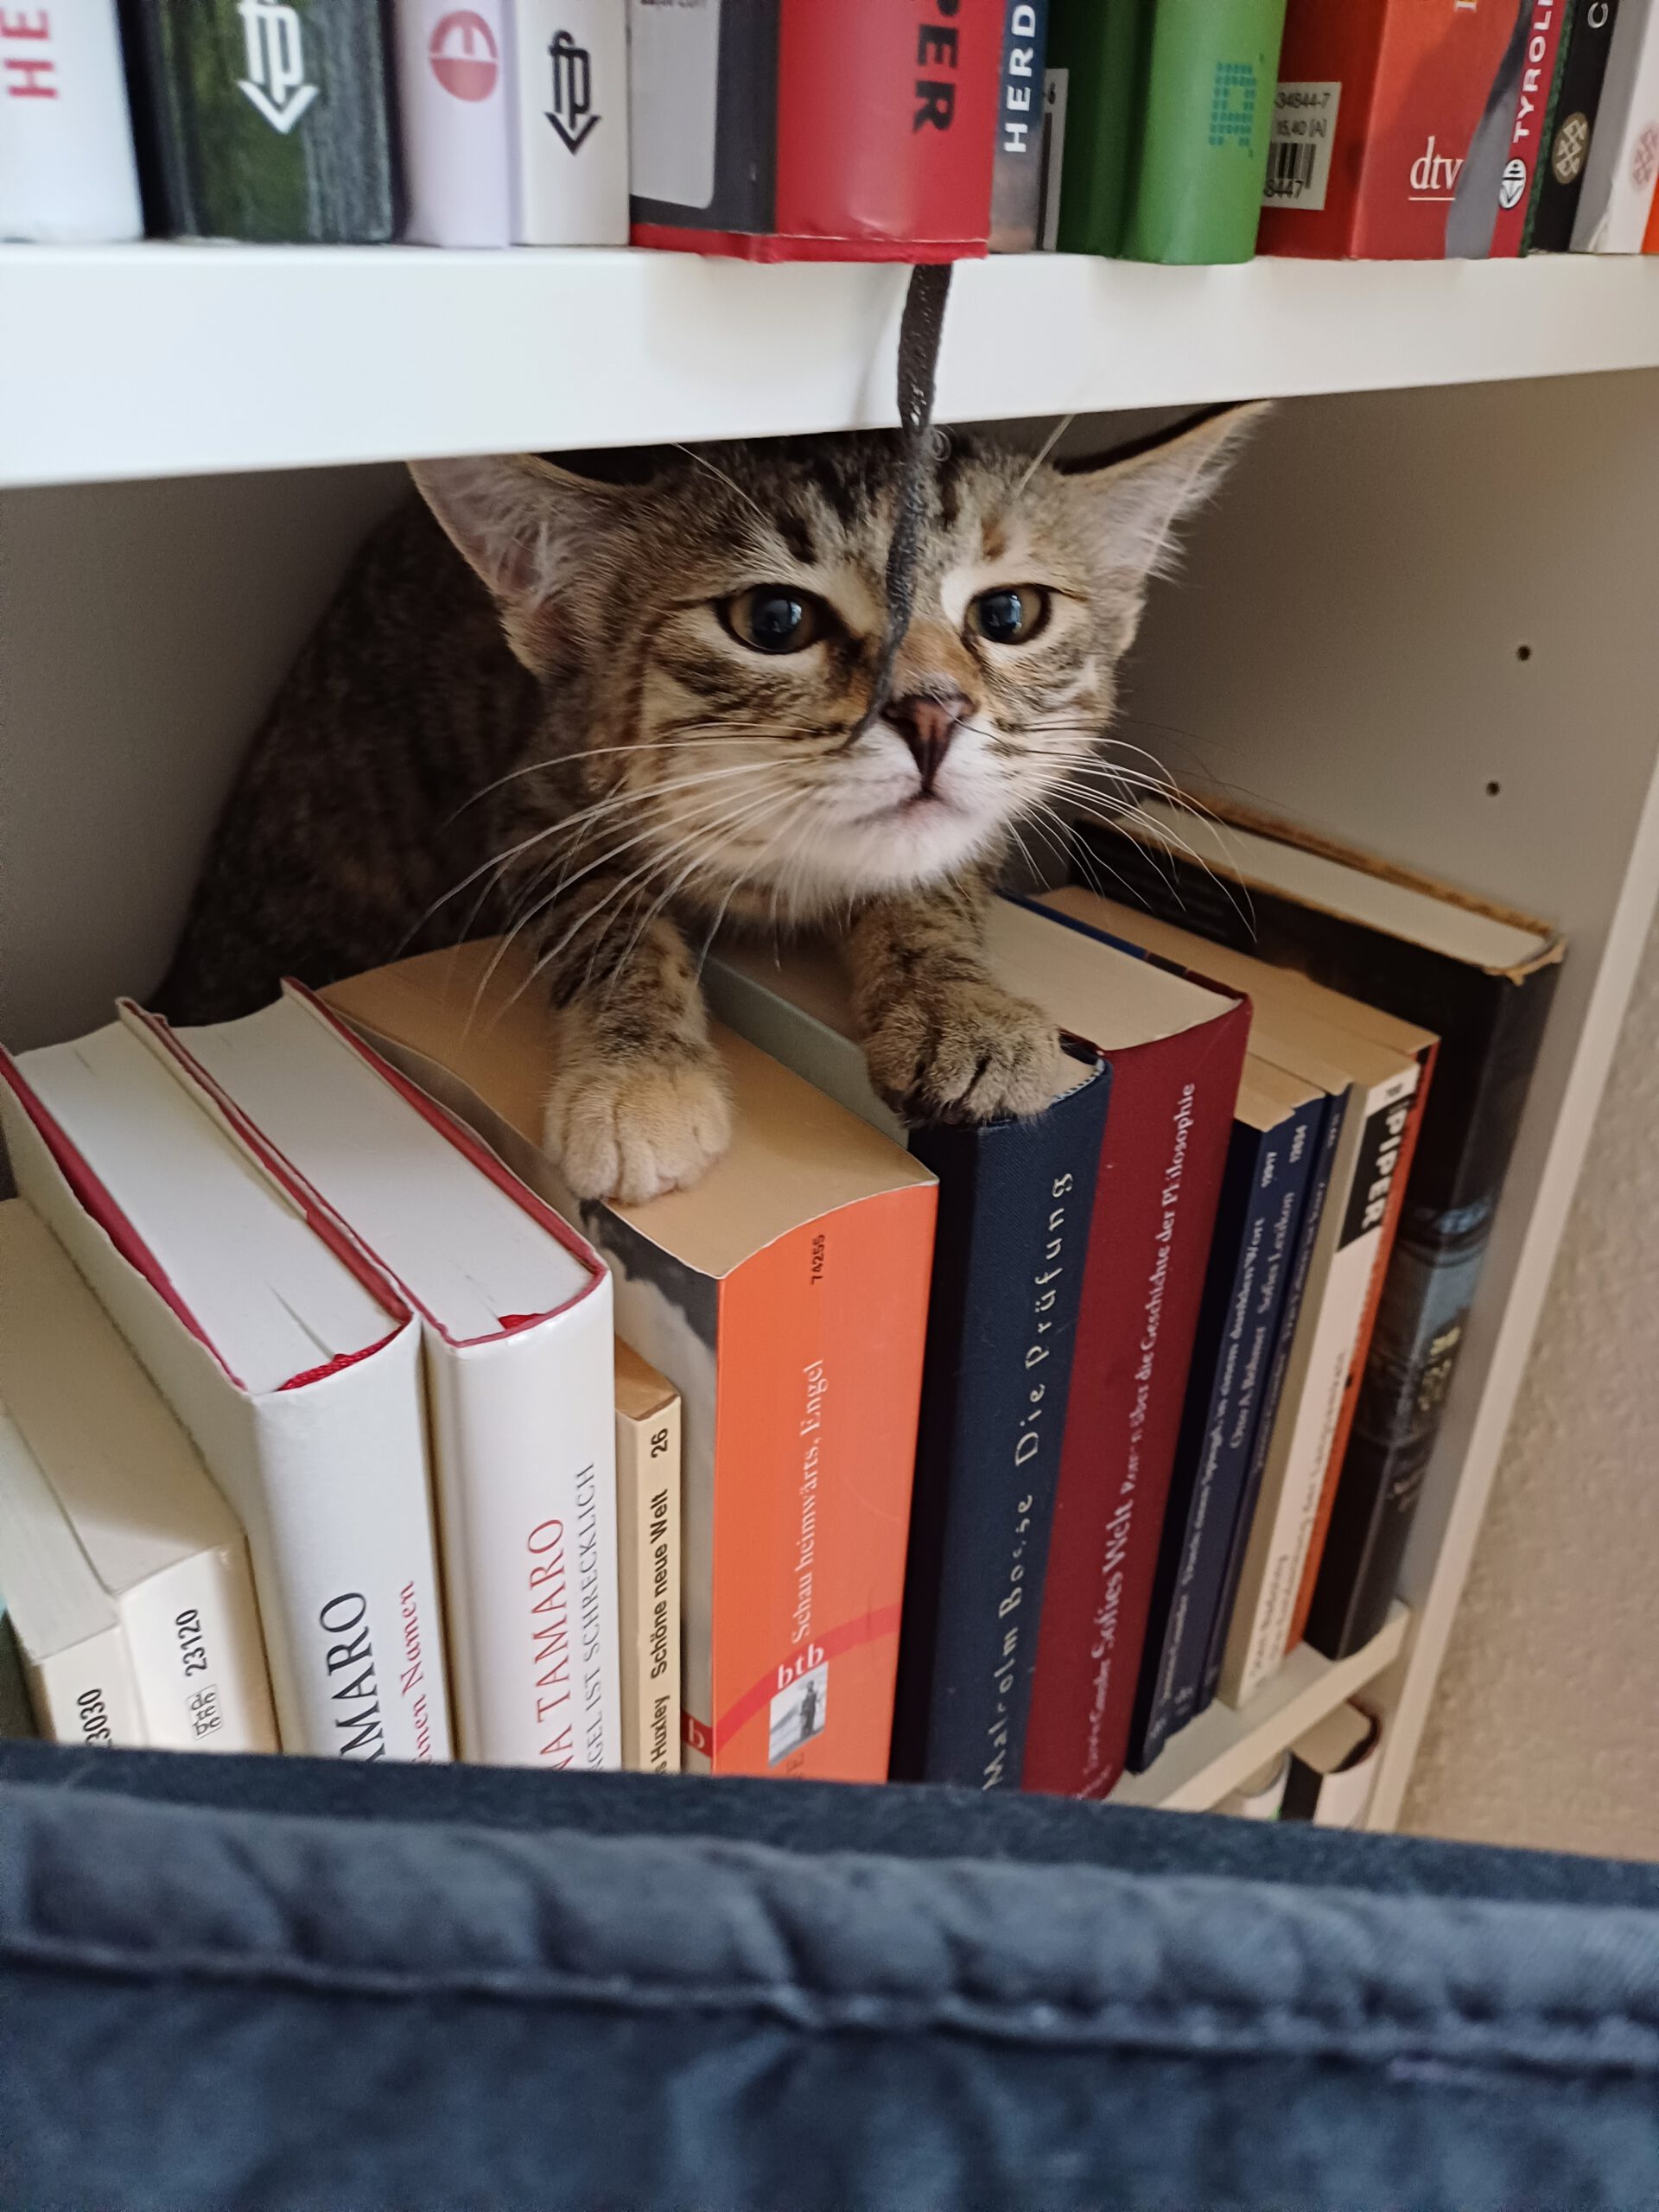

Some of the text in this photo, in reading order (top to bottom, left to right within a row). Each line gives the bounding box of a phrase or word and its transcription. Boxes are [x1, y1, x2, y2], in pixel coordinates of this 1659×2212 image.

[1003, 4, 1036, 153] HERD
[1409, 136, 1465, 191] dtv
[1161, 1082, 1197, 1207] Philosophie
[1361, 1109, 1408, 1230] PIPER
[810, 1233, 826, 1286] 74255
[1155, 1210, 1177, 1243] der
[1025, 1173, 1073, 1370] Prüfung
[1141, 1243, 1172, 1351] Geschichte
[799, 1358, 829, 1438] Engel
[1135, 1351, 1155, 1382] die
[650, 1427, 669, 1459] 26
[1014, 1382, 1046, 1467] Die
[650, 1489, 669, 1544] Welt
[575, 1462, 601, 1662] SCHRECKLICH
[654, 1544, 669, 1597] neue
[400, 1580, 424, 1698] Namen
[526, 1518, 571, 1724] TAMARO
[650, 1600, 669, 1680] Schöne
[791, 1571, 813, 1644] Schau
[175, 1609, 208, 1677] 23120
[777, 1643, 826, 1691] btb
[76, 1688, 112, 1745] 3030
[191, 1692, 216, 1711] de
[584, 1667, 601, 1711] IST
[650, 1694, 671, 1764] Huxley
